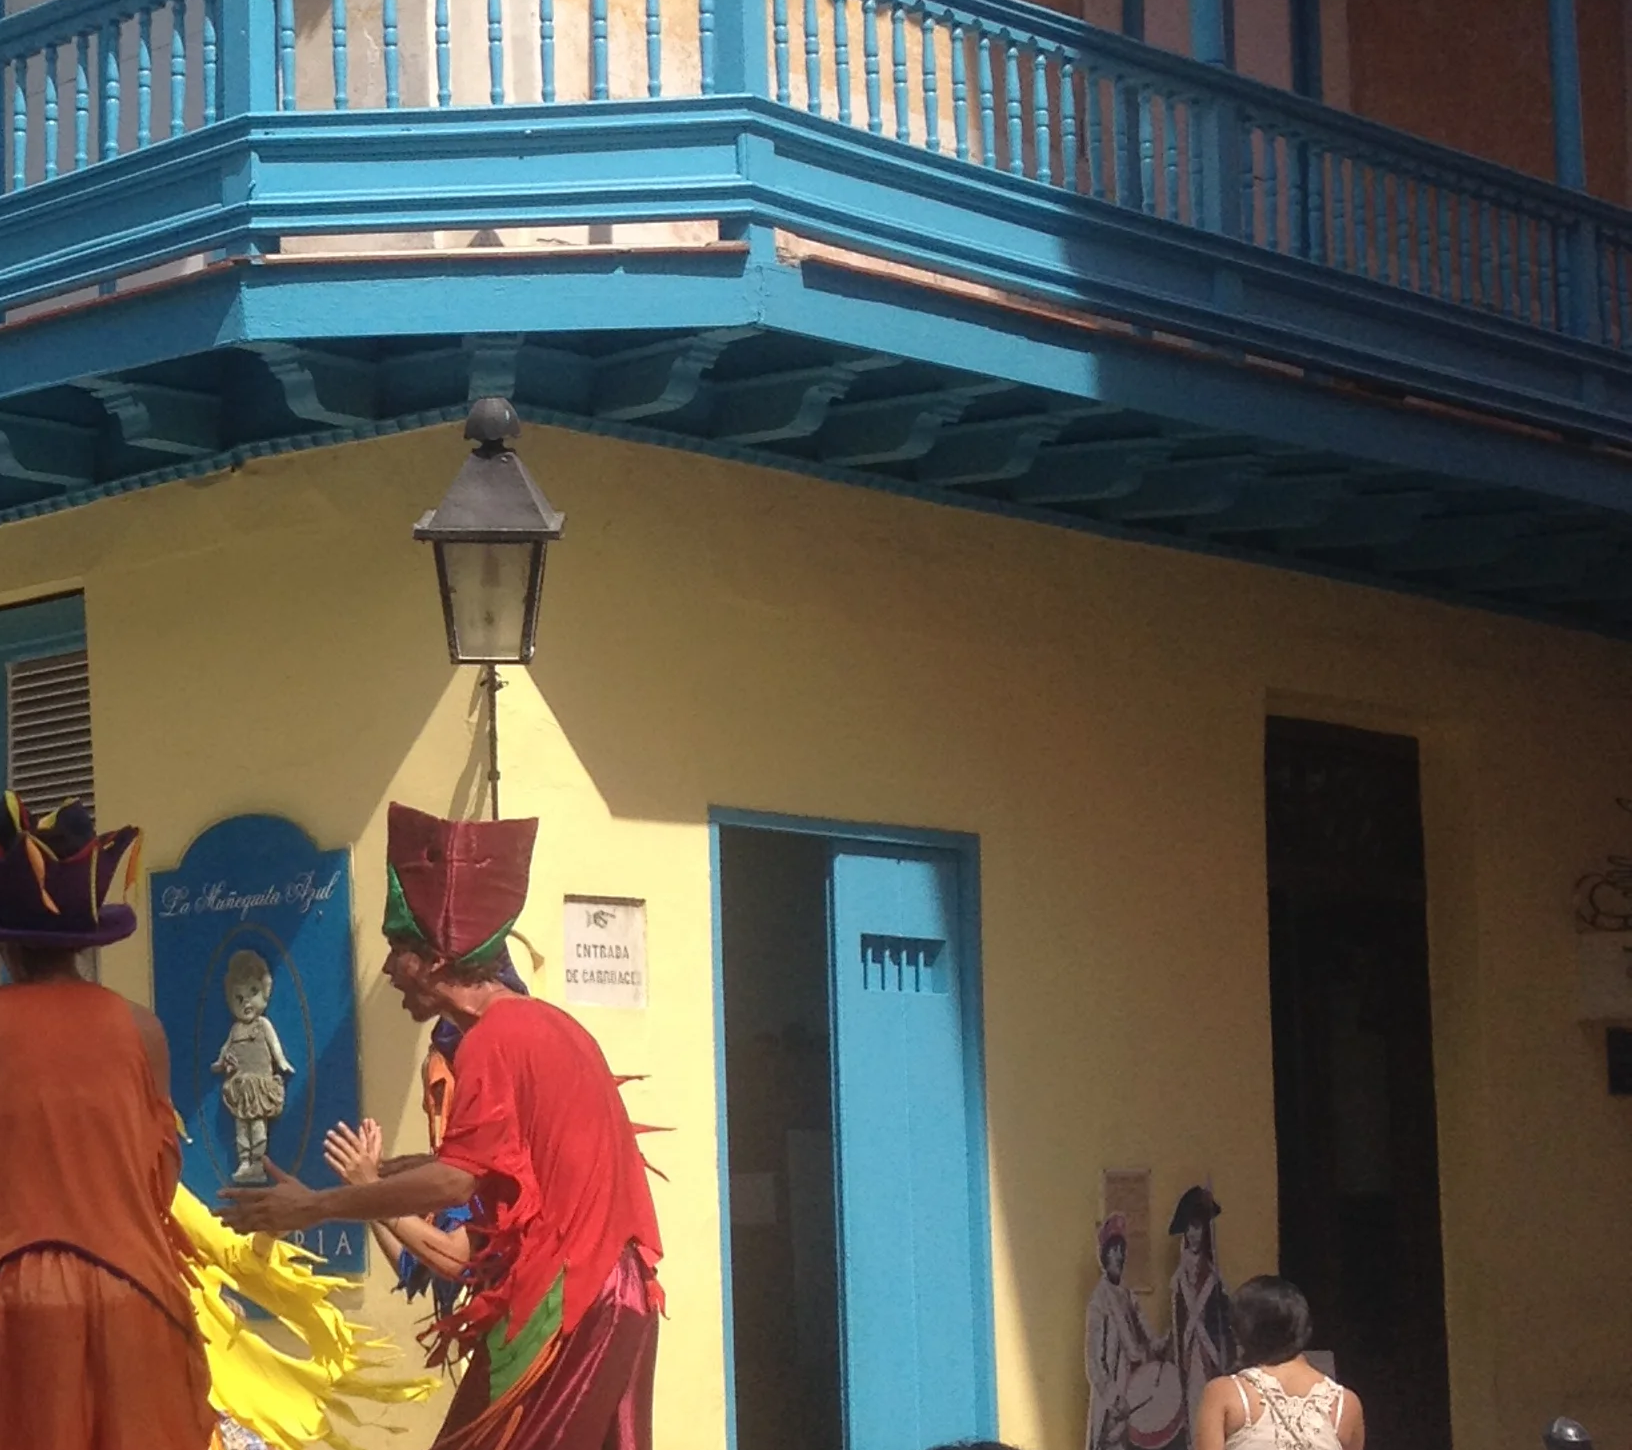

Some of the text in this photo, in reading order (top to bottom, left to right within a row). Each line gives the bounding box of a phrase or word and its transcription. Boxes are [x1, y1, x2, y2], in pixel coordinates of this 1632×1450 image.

[159, 885, 190, 918] La
[285, 870, 342, 913] Azul
[565, 969, 579, 984] DE
